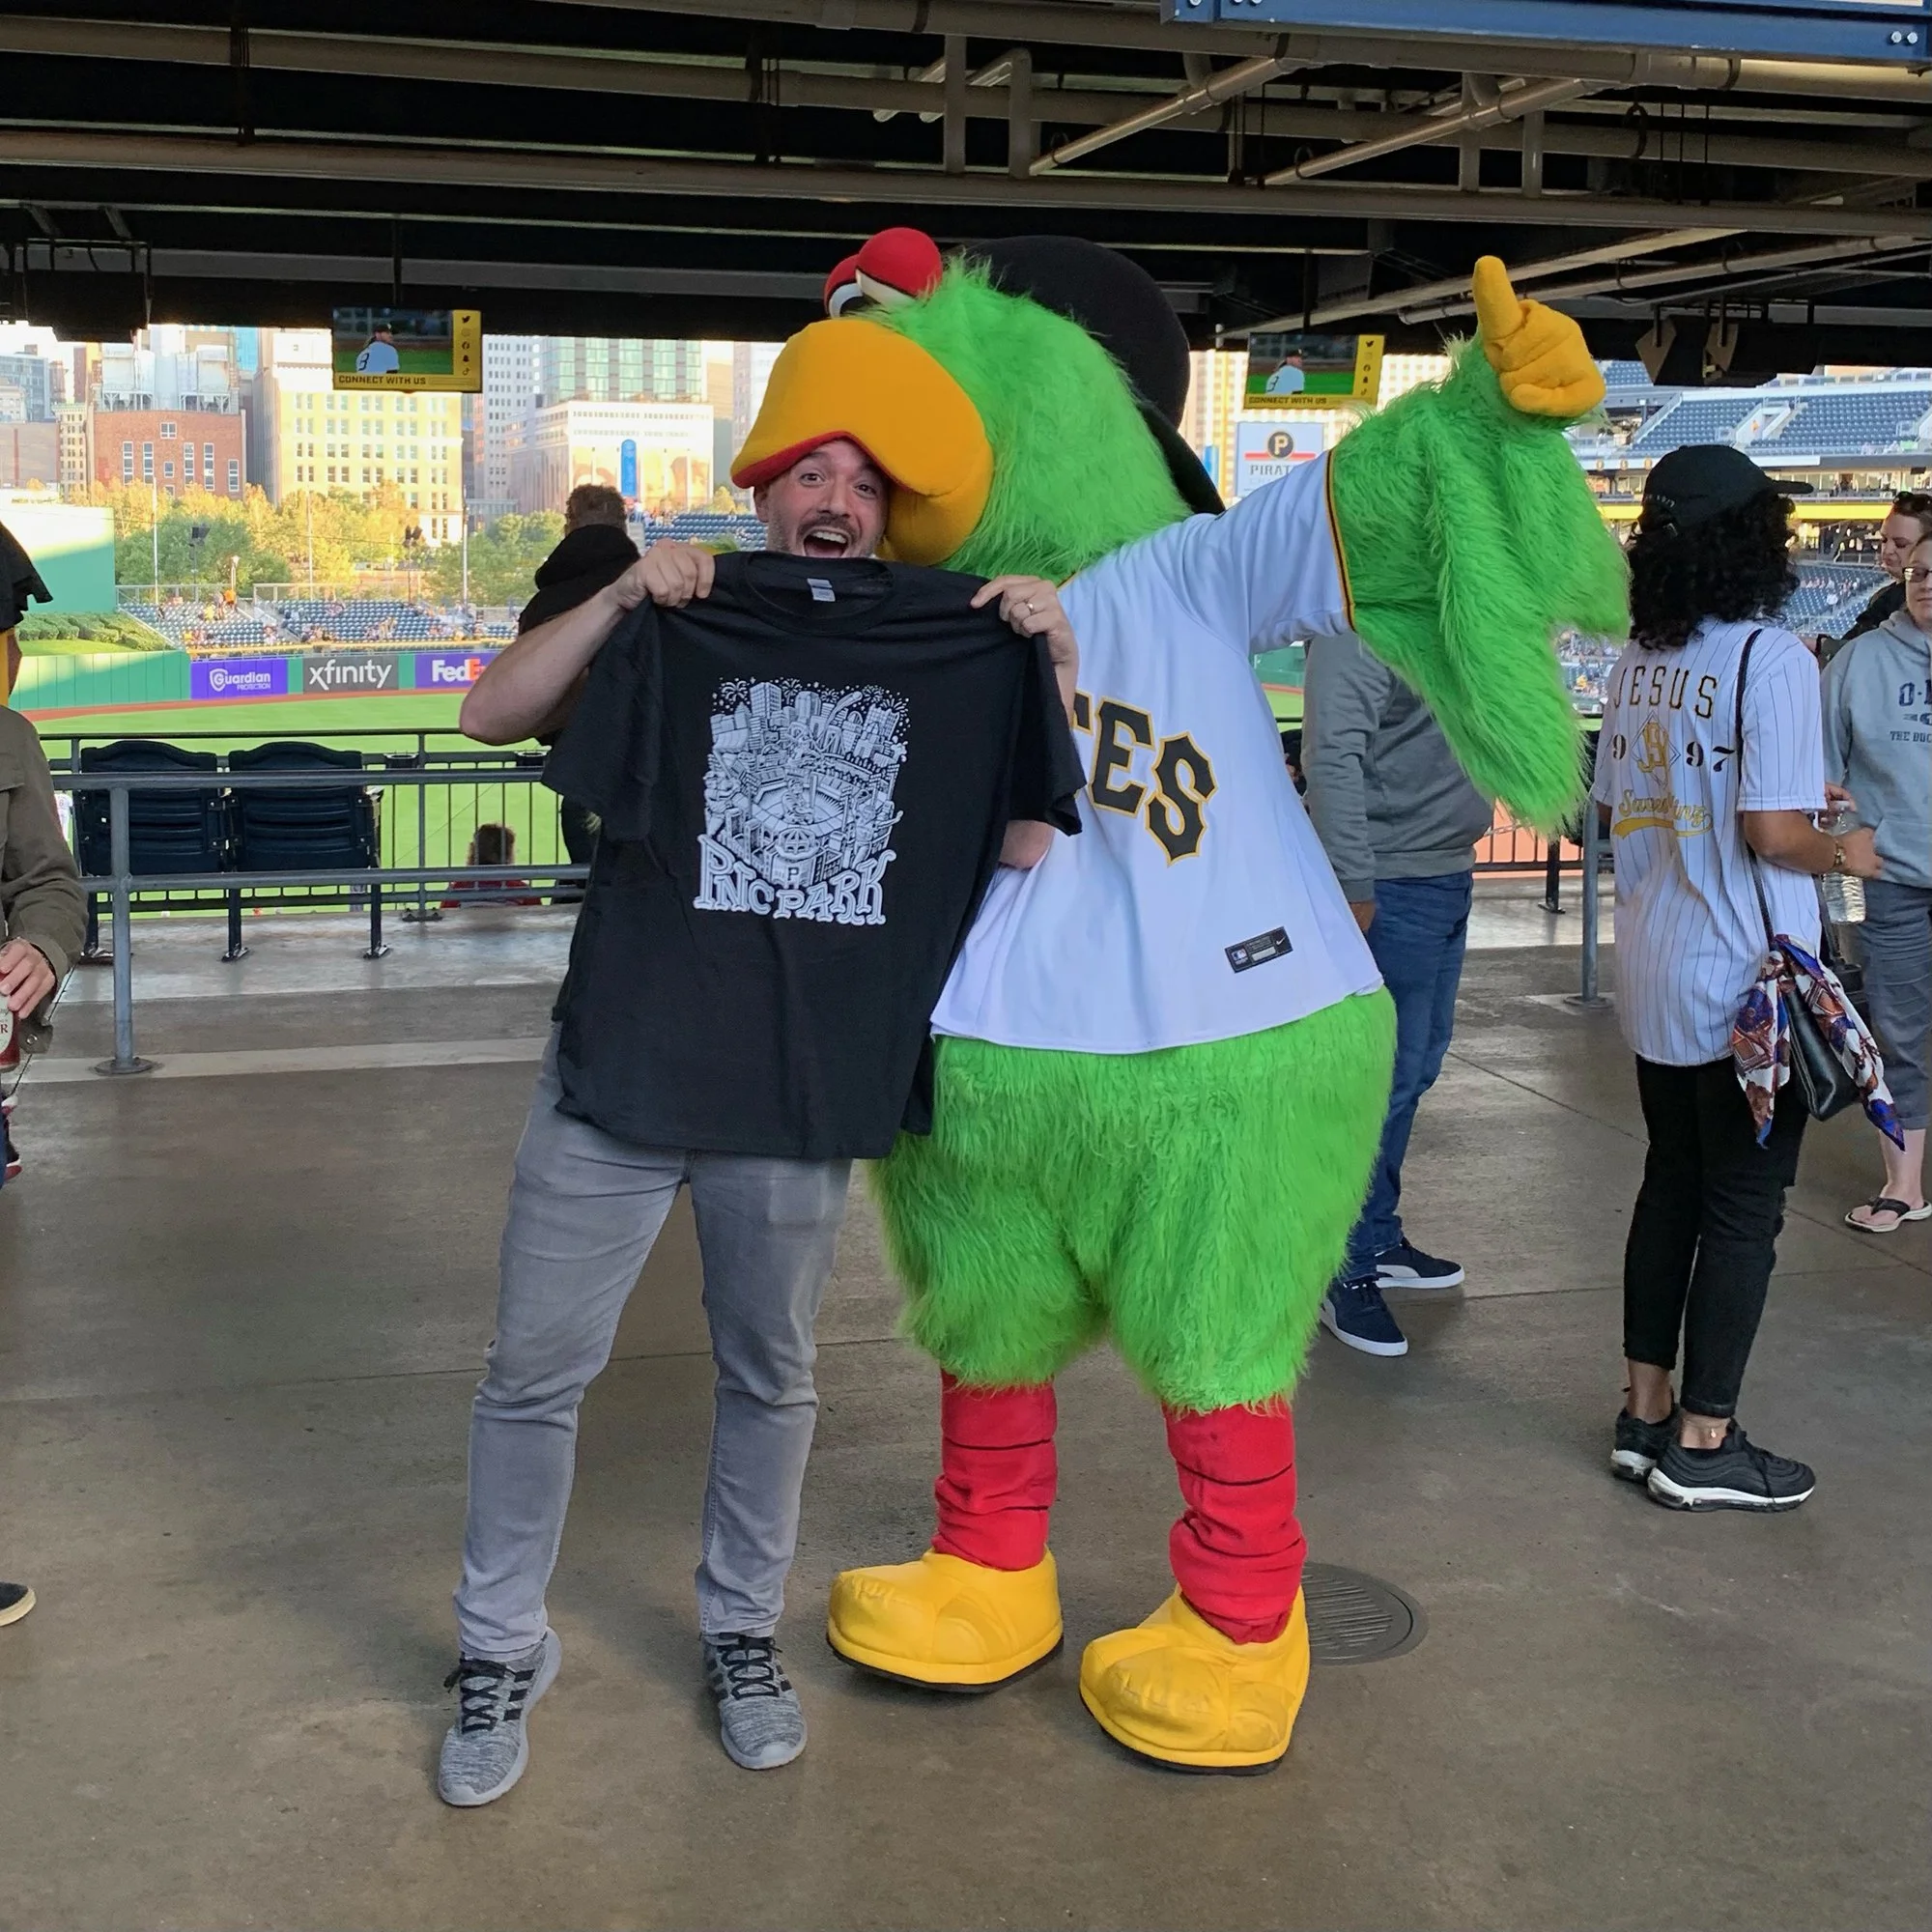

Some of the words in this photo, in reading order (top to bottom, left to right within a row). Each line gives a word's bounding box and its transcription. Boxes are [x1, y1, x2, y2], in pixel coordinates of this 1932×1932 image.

[338, 375, 384, 384] CONNECT
[386, 376, 411, 384] WITH
[413, 377, 426, 385] US
[1273, 436, 1289, 456] P
[1250, 465, 1293, 475] PIRAT
[213, 669, 271, 687] Guardian
[309, 659, 392, 691] xfinity
[1613, 666, 1718, 719] JESUS
[1889, 730, 1911, 741] THE
[1686, 741, 1736, 772] 97
[693, 834, 775, 916] PNC
[774, 849, 896, 925] PARK
[787, 867, 800, 881] P
